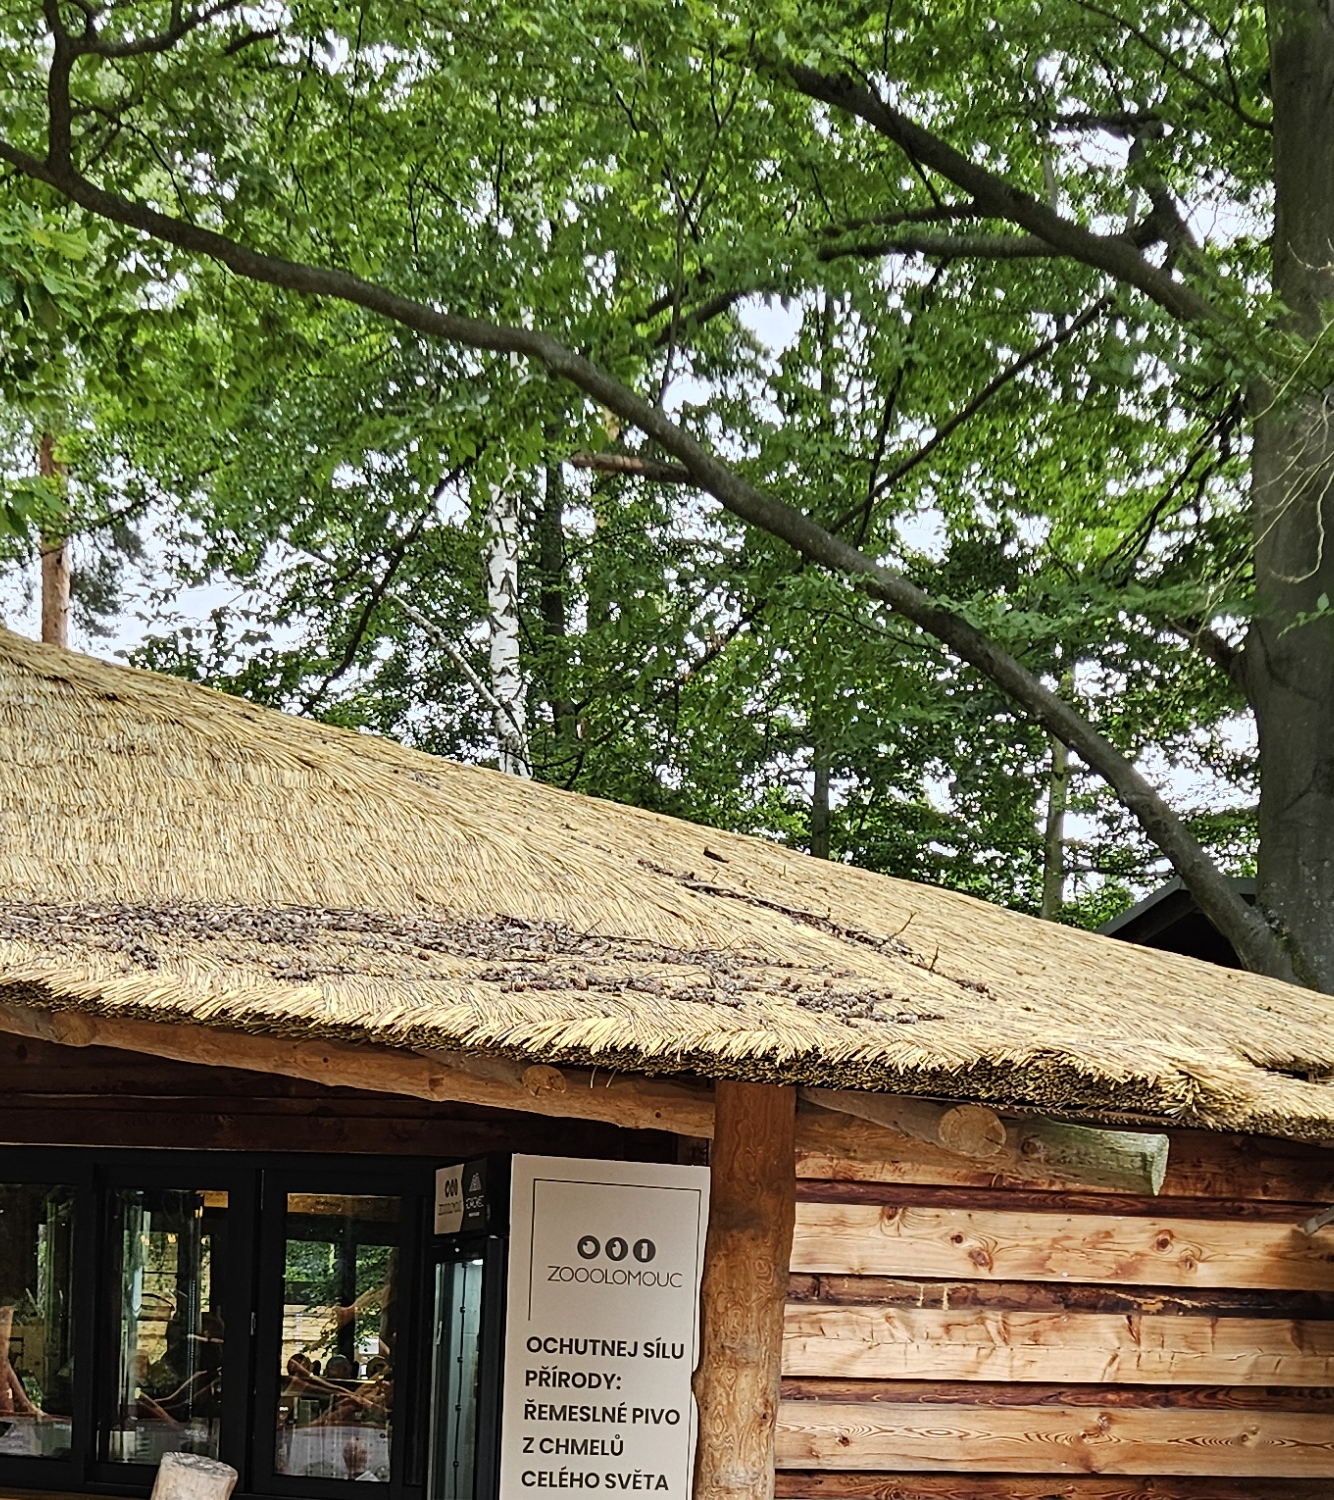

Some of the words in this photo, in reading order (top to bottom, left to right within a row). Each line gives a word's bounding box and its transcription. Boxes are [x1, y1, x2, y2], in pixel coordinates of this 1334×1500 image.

[547, 1265, 683, 1288] ZOOOLOMOUC
[526, 1336, 638, 1357] OCHUTNEJ
[643, 1337, 685, 1360] SÍLU
[525, 1365, 622, 1390] PŘÍRODY:
[523, 1398, 627, 1424] ŘEMESLNÉ
[632, 1407, 680, 1425] PIVO
[522, 1436, 535, 1454] Z
[539, 1434, 624, 1457] CHMELŮ
[521, 1466, 600, 1489] CELÉHO
[605, 1469, 669, 1491] SVĚTA
